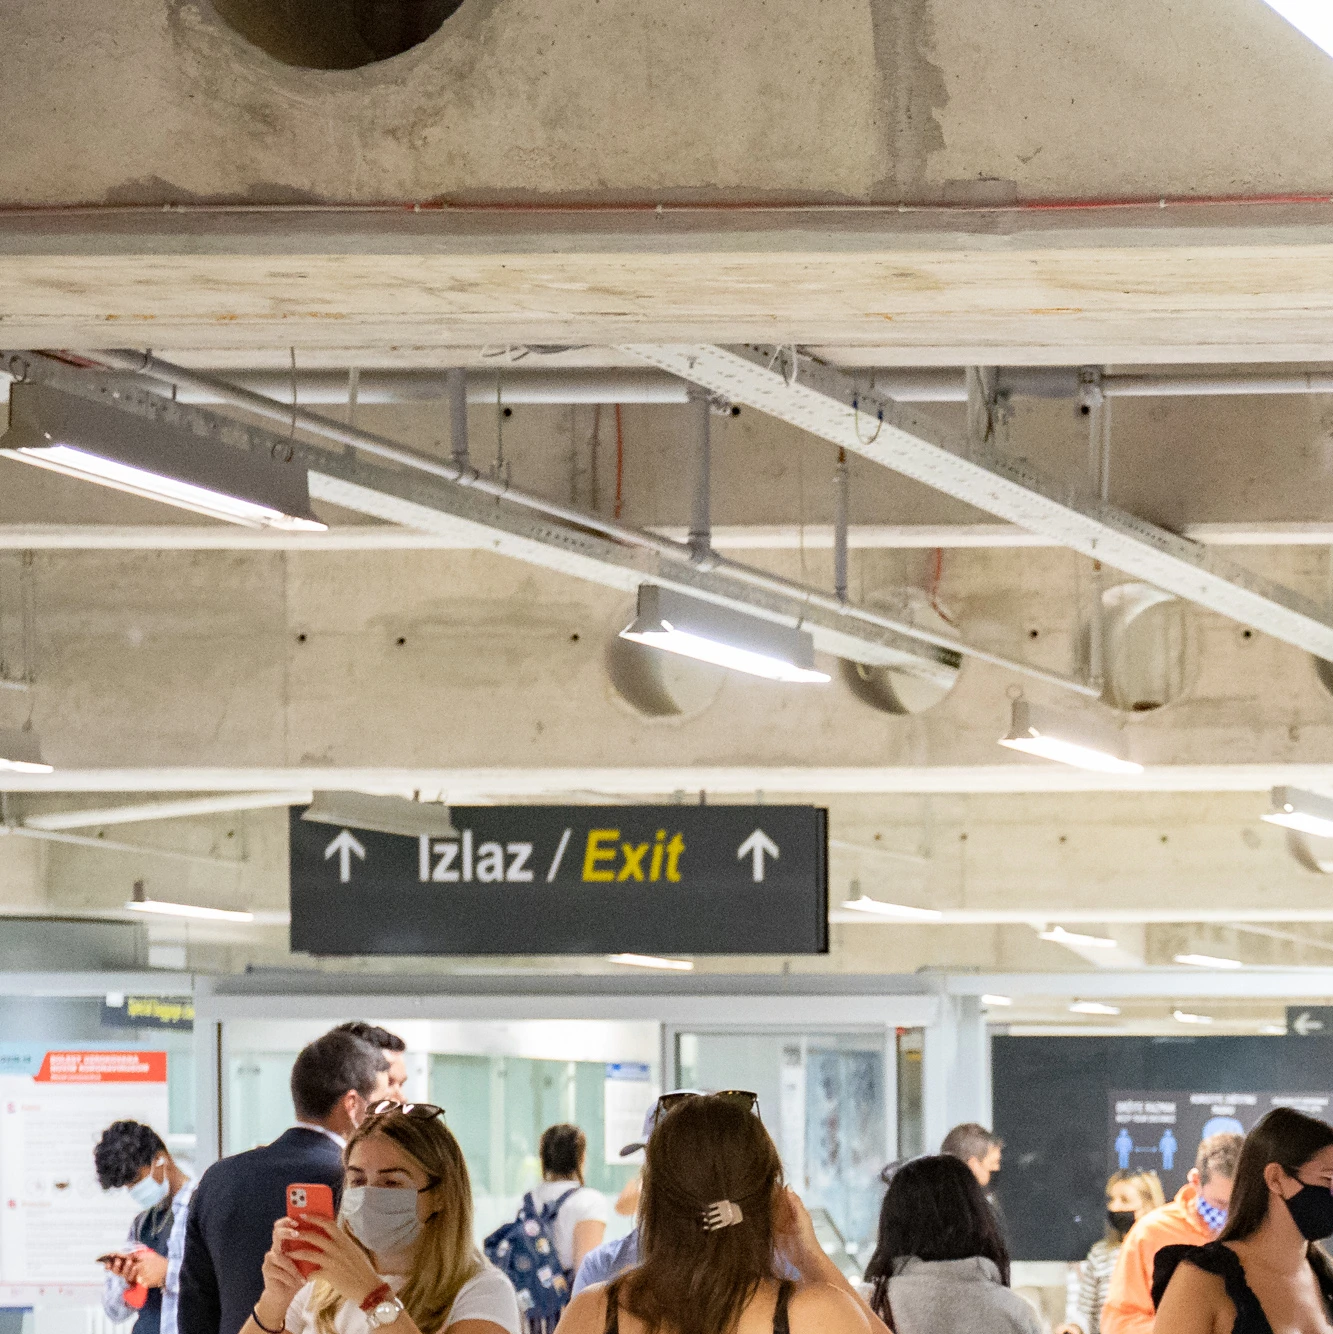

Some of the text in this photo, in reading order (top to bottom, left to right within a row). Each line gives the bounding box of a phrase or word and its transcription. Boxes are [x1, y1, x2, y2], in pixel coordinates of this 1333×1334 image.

[419, 828, 685, 883] Izlaz / Exit
